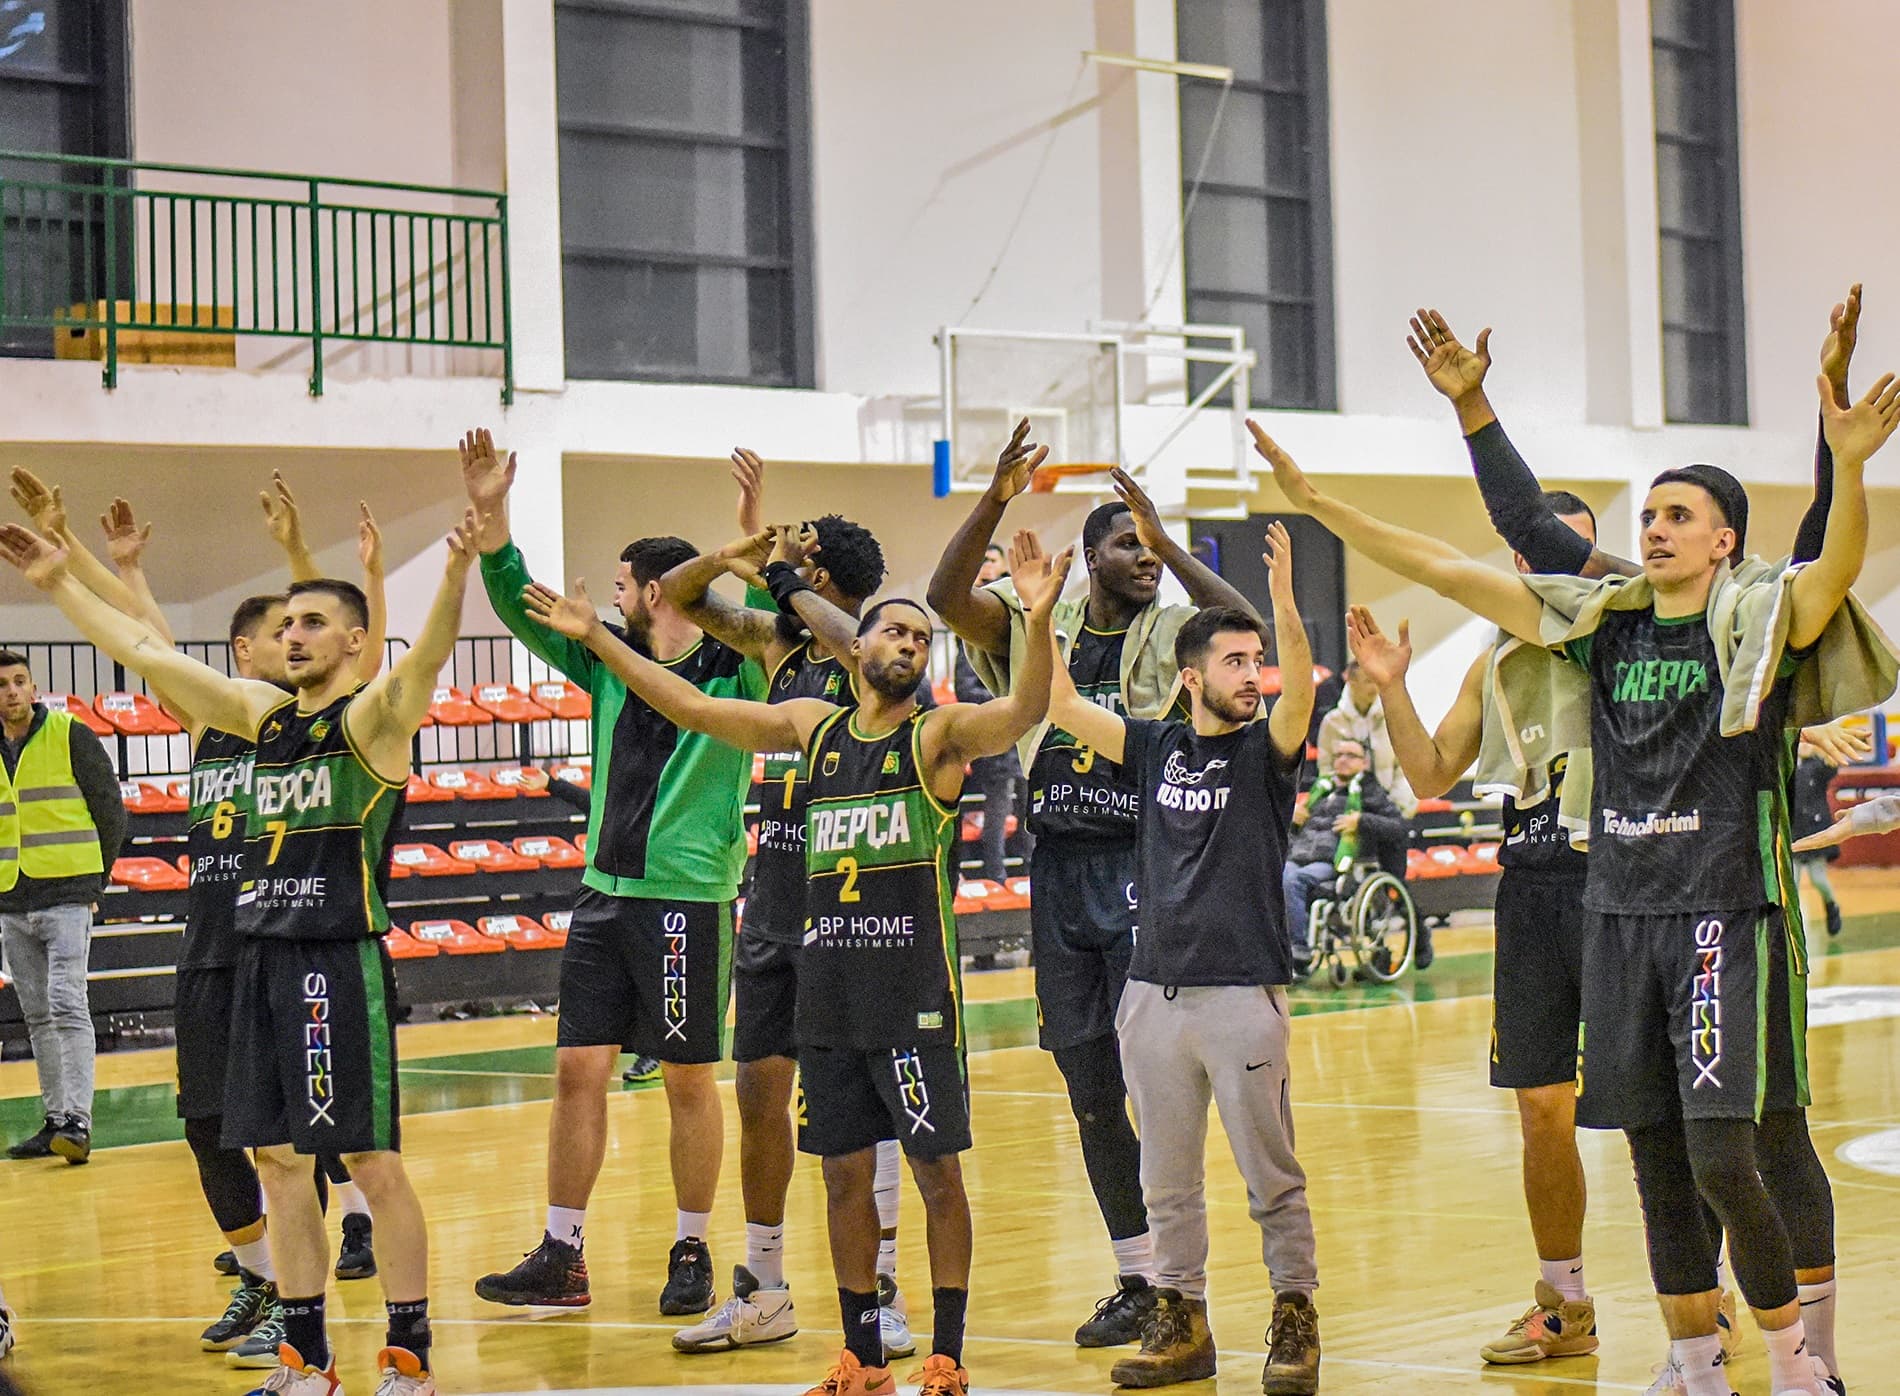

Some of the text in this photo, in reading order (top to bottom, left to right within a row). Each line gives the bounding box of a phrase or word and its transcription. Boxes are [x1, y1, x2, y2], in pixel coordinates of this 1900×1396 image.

[1071, 739, 1096, 774] 3
[783, 768, 798, 810] 1
[1050, 784, 1140, 812] BP HOME
[1184, 788, 1212, 812] DO
[1213, 786, 1231, 810] IT
[211, 801, 237, 840] 6
[766, 819, 781, 838] BP
[1529, 814, 1550, 835] BP
[265, 820, 287, 866] 7
[197, 855, 215, 873] BP
[273, 877, 327, 896] HOME
[836, 856, 861, 903] 2
[819, 915, 914, 936] BP HOME
[820, 937, 914, 949] INVESTMENT
